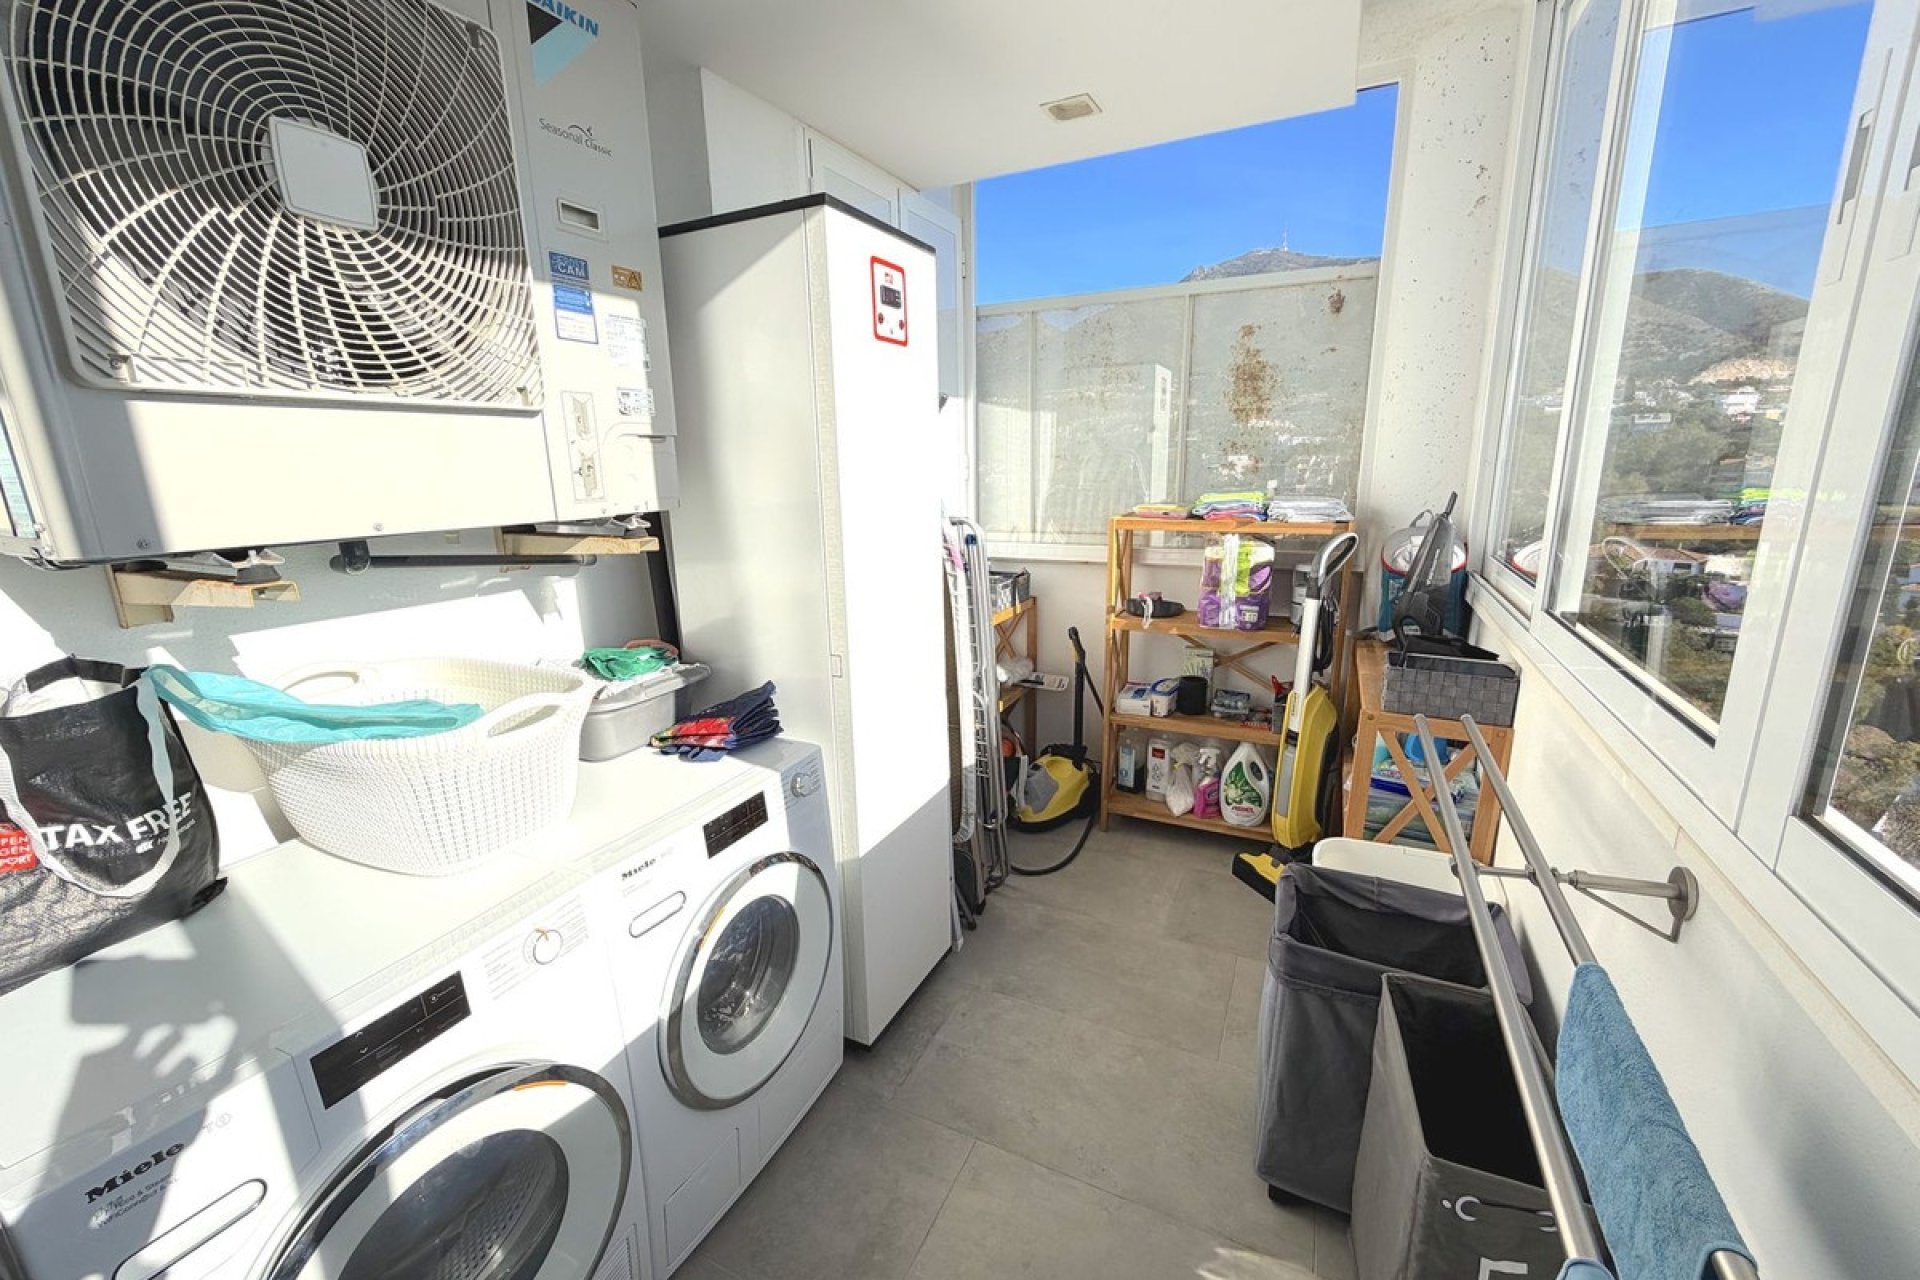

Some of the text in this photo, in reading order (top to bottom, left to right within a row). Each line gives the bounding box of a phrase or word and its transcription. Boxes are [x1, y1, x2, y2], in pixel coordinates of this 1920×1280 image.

[532, 0, 600, 37] AIKIN
[38, 823, 124, 851] TAX
[84, 1143, 185, 1204] Miele
